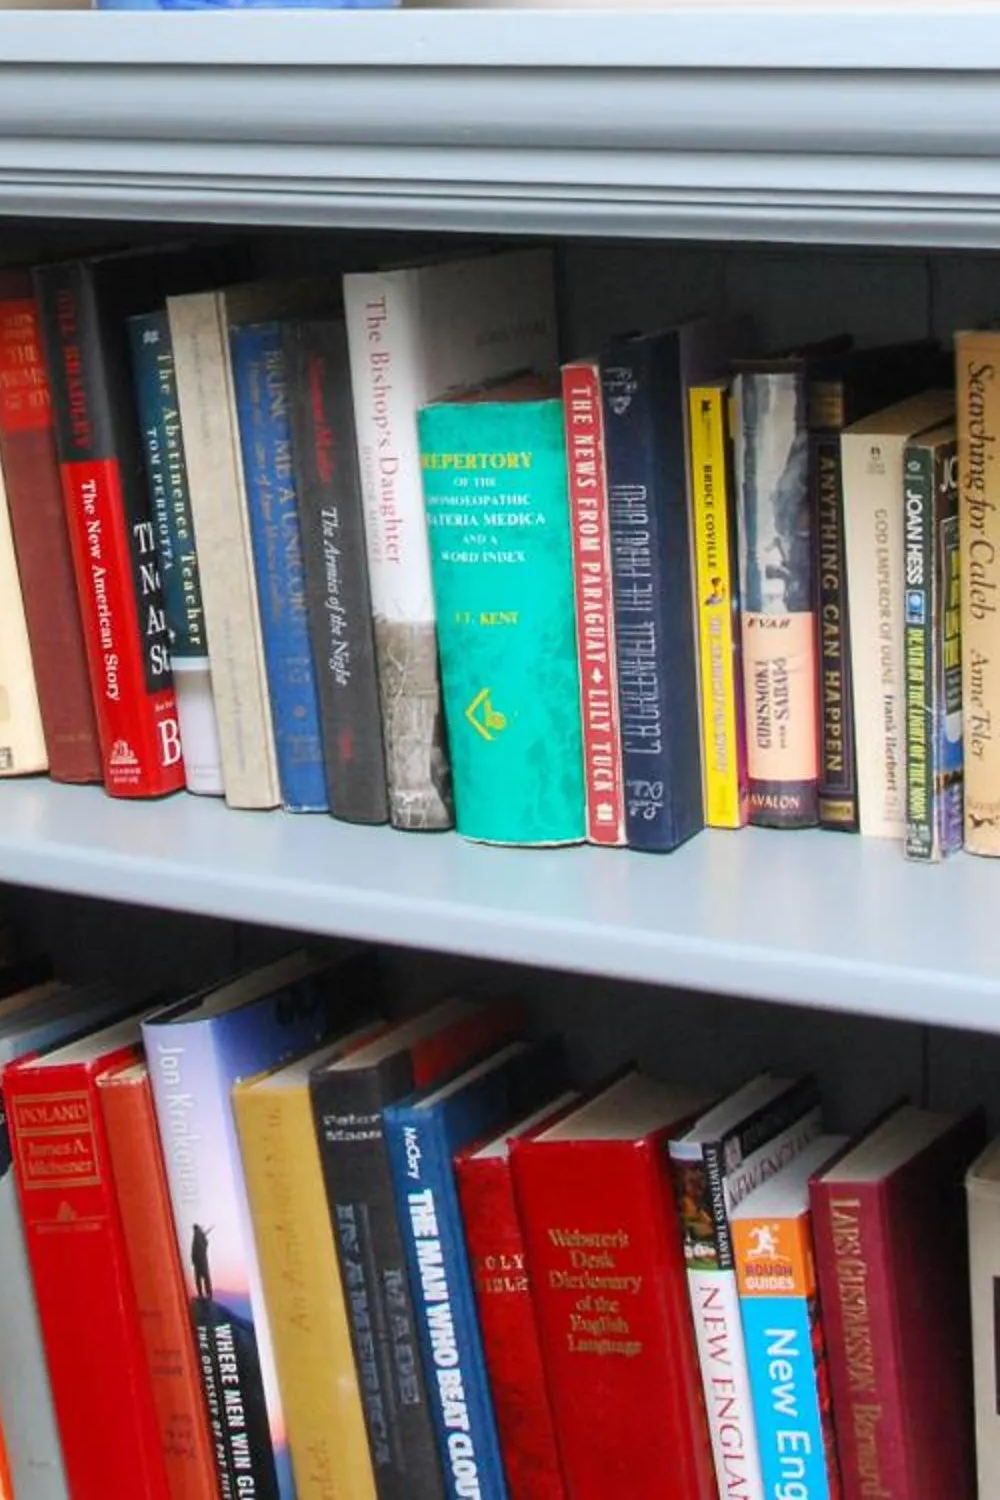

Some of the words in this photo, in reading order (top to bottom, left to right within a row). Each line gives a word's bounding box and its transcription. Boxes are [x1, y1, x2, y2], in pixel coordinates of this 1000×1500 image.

[366, 296, 388, 344] The
[157, 354, 173, 396] The
[370, 352, 394, 449] Bishop's
[571, 387, 594, 426] THE
[147, 428, 161, 466] TOM
[967, 362, 995, 495] Searching
[162, 407, 190, 540] Abstinence
[276, 439, 293, 478] ME
[420, 452, 533, 469] REPERTORY
[574, 435, 597, 489] NEWS
[80, 479, 97, 516] The
[277, 487, 297, 504] A
[474, 476, 497, 487] THE
[703, 464, 714, 507] BRUCE
[152, 473, 173, 571] PERROTTA
[379, 456, 404, 564] Daughter
[483, 512, 546, 526] MEDICA
[578, 498, 602, 553] FROM
[819, 456, 840, 589] ANYTHING
[875, 508, 889, 541] GOD
[905, 489, 924, 541] JOAN
[965, 495, 988, 536] for
[84, 520, 102, 559] New
[441, 552, 479, 564] WORD
[482, 552, 526, 563] INDEX
[463, 533, 486, 546] AND
[705, 513, 718, 568] COVILLE
[876, 546, 894, 623] EMPEROR
[906, 545, 925, 586] HESS
[967, 539, 998, 621] Caleb
[92, 565, 113, 649] American
[180, 551, 201, 646] Teacher
[321, 507, 337, 538] The
[329, 639, 351, 687] Night
[479, 611, 519, 625] KENT
[581, 562, 608, 663] PARAGUAY
[823, 605, 841, 658] CAN
[104, 652, 120, 701] Story
[880, 643, 895, 687] DUNE
[969, 648, 990, 703] Anne
[588, 688, 611, 734] LILY
[823, 670, 844, 772] HAPPEN
[883, 694, 897, 727] Frank
[970, 707, 992, 760] Tyler
[591, 741, 614, 793] TUCK
[884, 729, 899, 793] Herbert
[157, 1043, 185, 1086] Jon
[19, 1104, 88, 1125] POLAND
[323, 1113, 383, 1126] Peter
[28, 1140, 74, 1158] James
[28, 1159, 93, 1176] Michener
[166, 1091, 201, 1205] Krakauer
[408, 1188, 439, 1238] THE
[706, 1148, 725, 1222] EYEWITNESS
[717, 1222, 731, 1267] TRAVEL
[831, 1198, 862, 1256] LARS
[548, 1229, 630, 1248] Webster's
[570, 1250, 615, 1270] Desk
[416, 1240, 449, 1301] MAN
[550, 1270, 642, 1293] Dictionary
[745, 1264, 793, 1277] ROUGH
[745, 1276, 796, 1291] GUIDES
[570, 1314, 630, 1336] English
[576, 1296, 592, 1311] of
[593, 1296, 620, 1312] the
[699, 1285, 732, 1367] NEW
[197, 1325, 210, 1349] THE
[215, 1323, 240, 1385] WHERE
[426, 1302, 459, 1367] WHO
[567, 1334, 643, 1358] Language
[202, 1355, 219, 1417] ODYSSEY
[764, 1326, 799, 1418] New
[224, 1388, 246, 1428] MEN
[436, 1368, 470, 1432] BEAT
[216, 1442, 229, 1470] PAT
[231, 1433, 252, 1470] WIN
